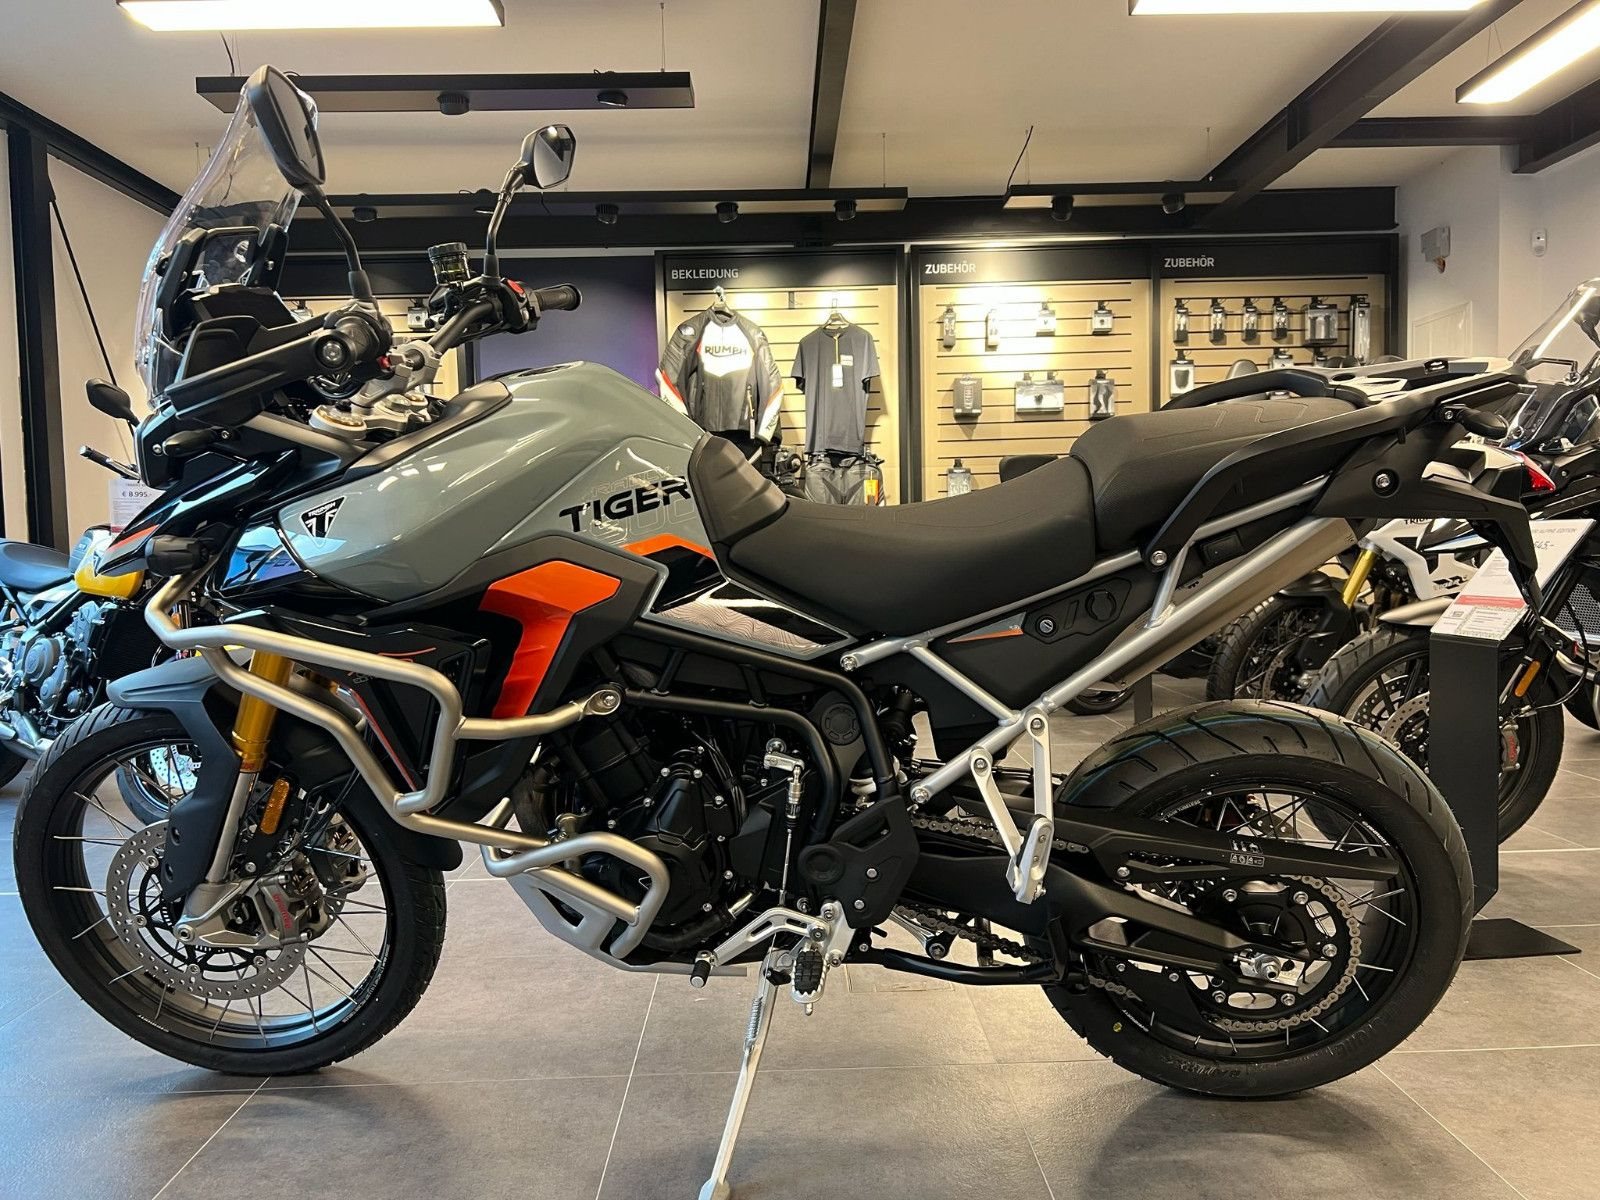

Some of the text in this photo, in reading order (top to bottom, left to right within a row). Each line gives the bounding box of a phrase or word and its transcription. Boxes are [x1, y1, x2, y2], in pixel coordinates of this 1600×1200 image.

[925, 260, 976, 274] ZUBEHÖR
[1164, 254, 1215, 267] ZUBEHÖR
[671, 268, 739, 280] BEKLEIDUNG
[559, 475, 691, 533] TIGER
